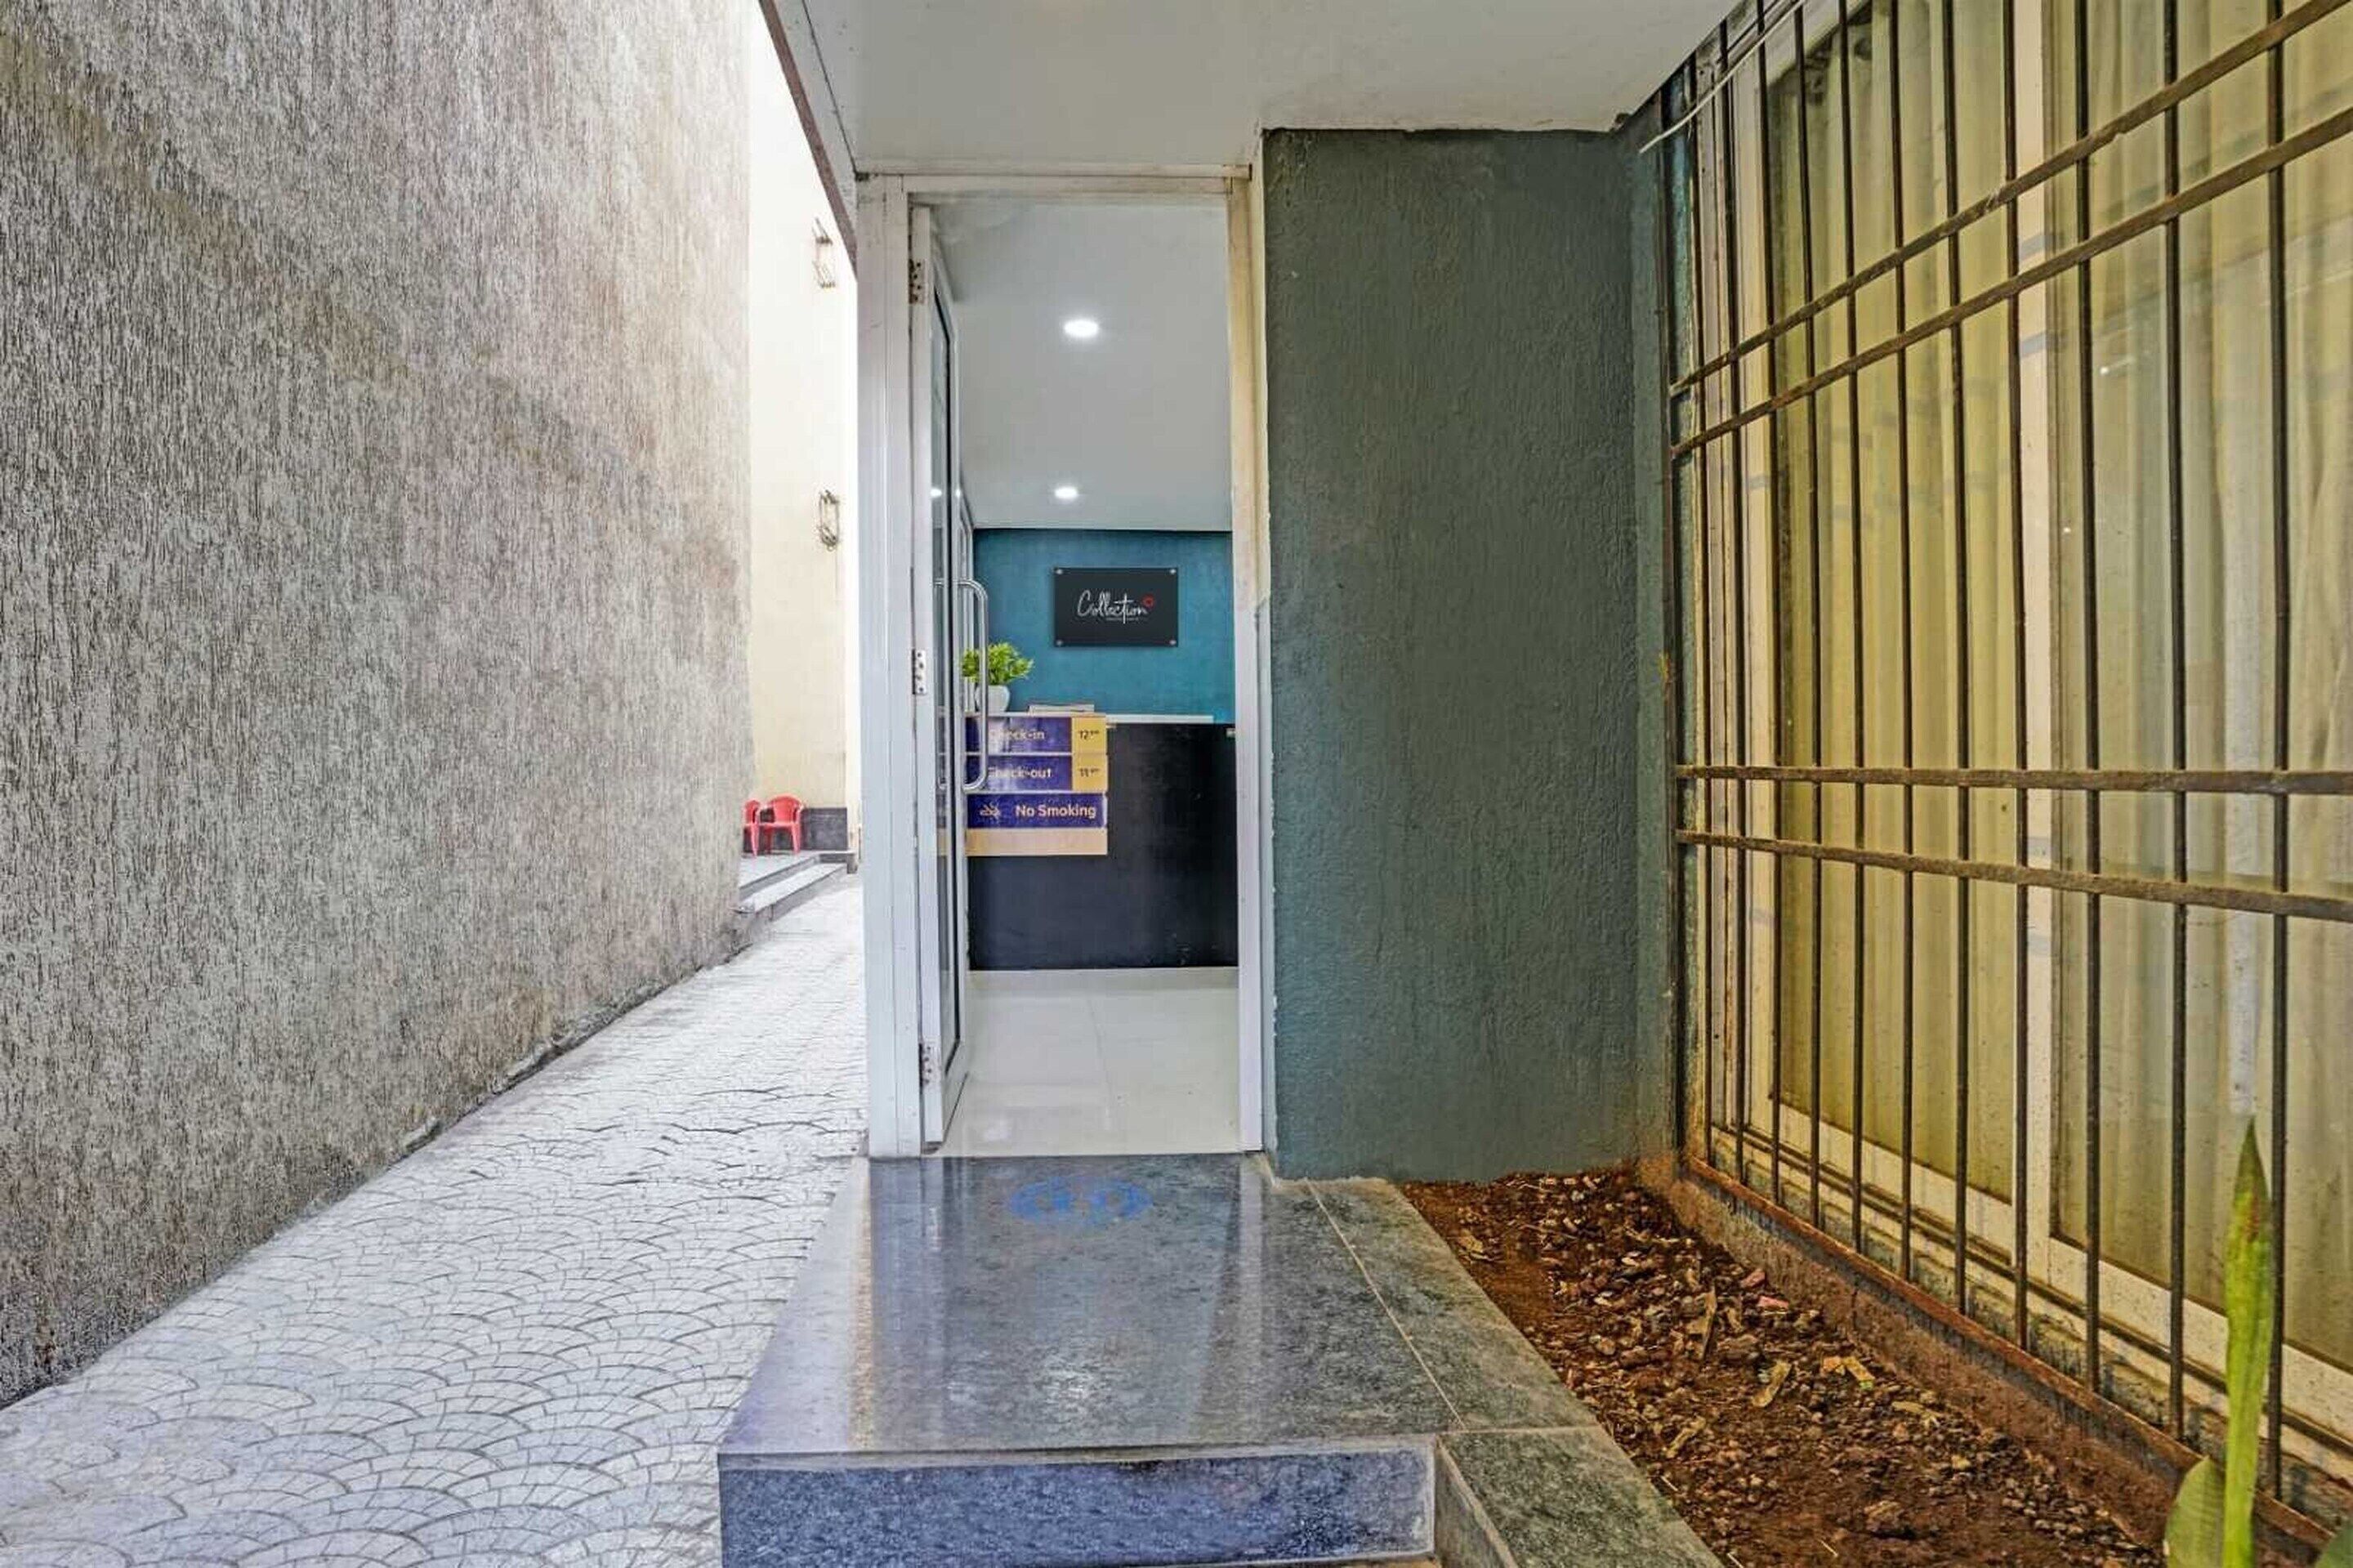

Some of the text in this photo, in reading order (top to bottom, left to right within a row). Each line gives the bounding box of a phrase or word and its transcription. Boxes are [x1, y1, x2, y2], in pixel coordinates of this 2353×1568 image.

[1077, 589, 1148, 624] Collection
[1016, 803, 1097, 819] No Smoking
